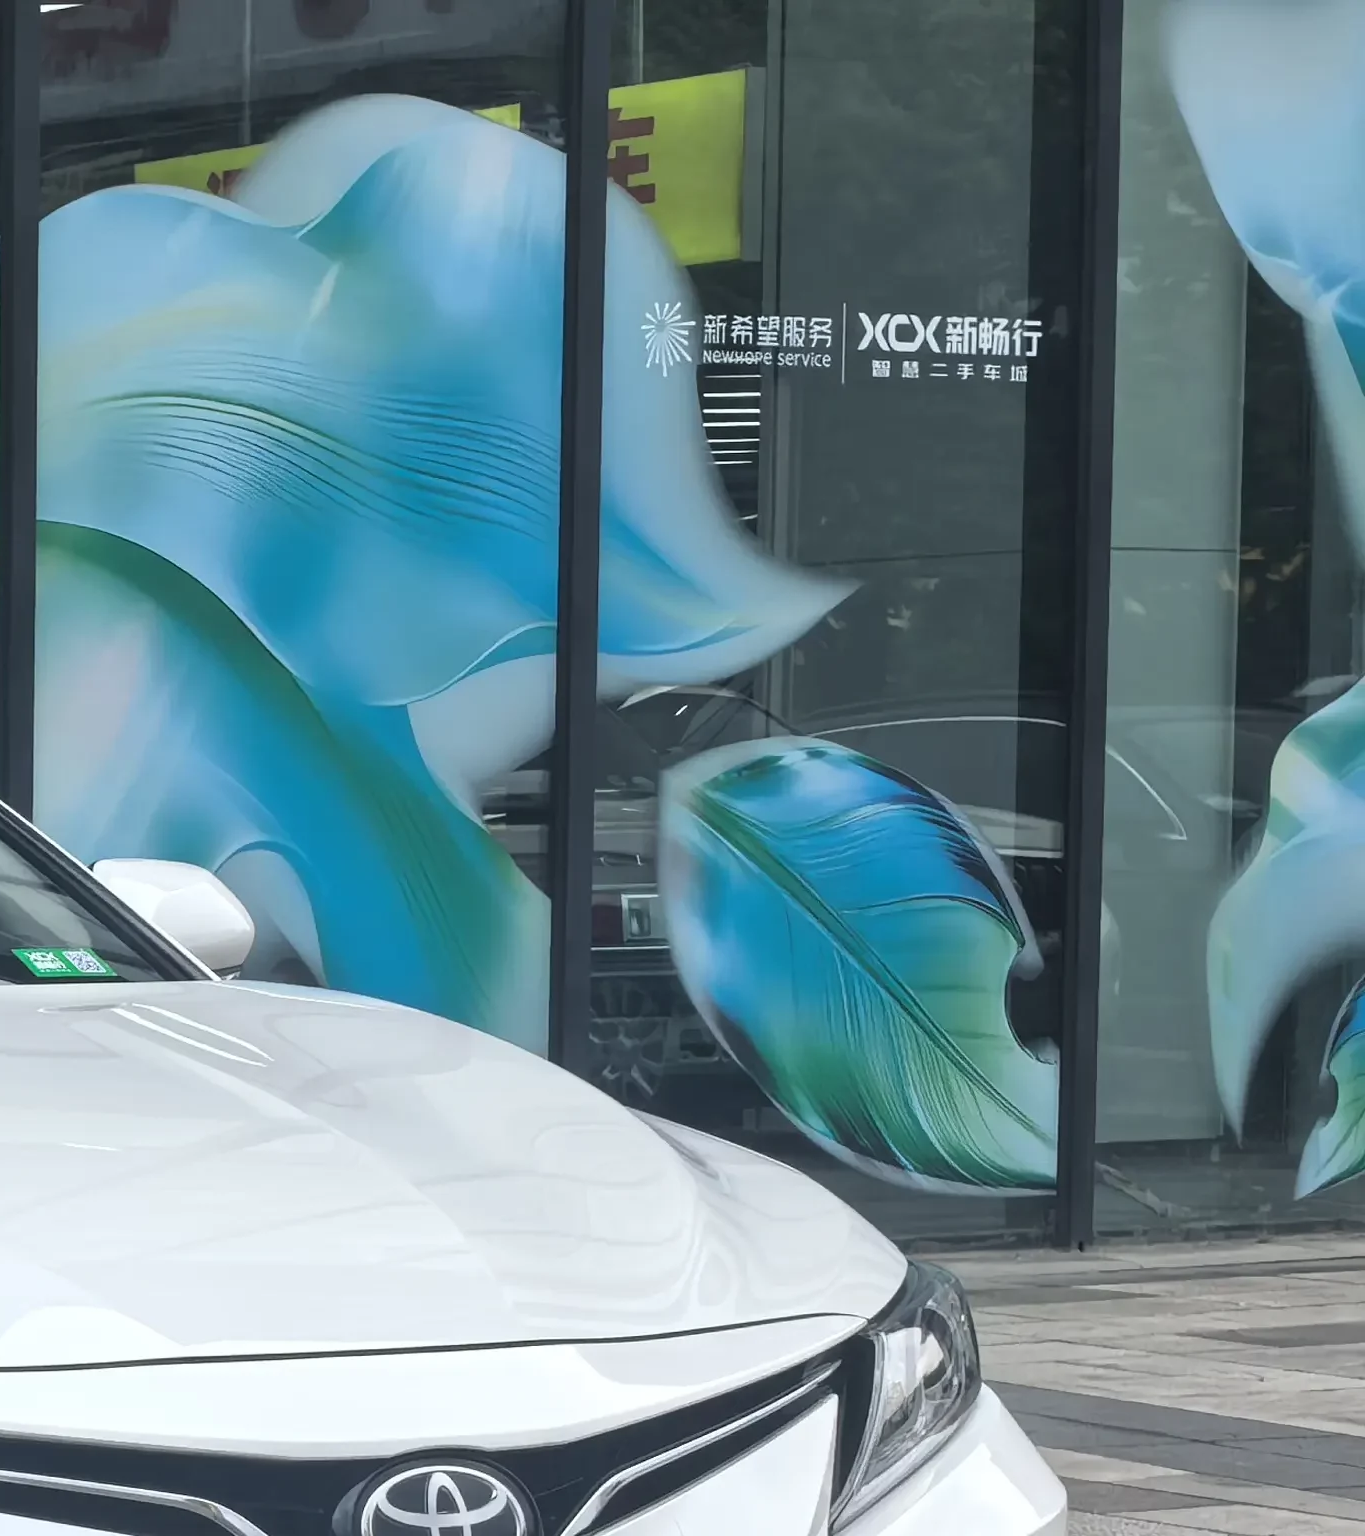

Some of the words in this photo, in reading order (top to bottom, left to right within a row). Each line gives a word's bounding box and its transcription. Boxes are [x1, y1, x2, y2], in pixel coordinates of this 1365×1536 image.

[702, 314, 833, 348] 新希望服务
[871, 359, 1029, 382] 智慧二手车城
